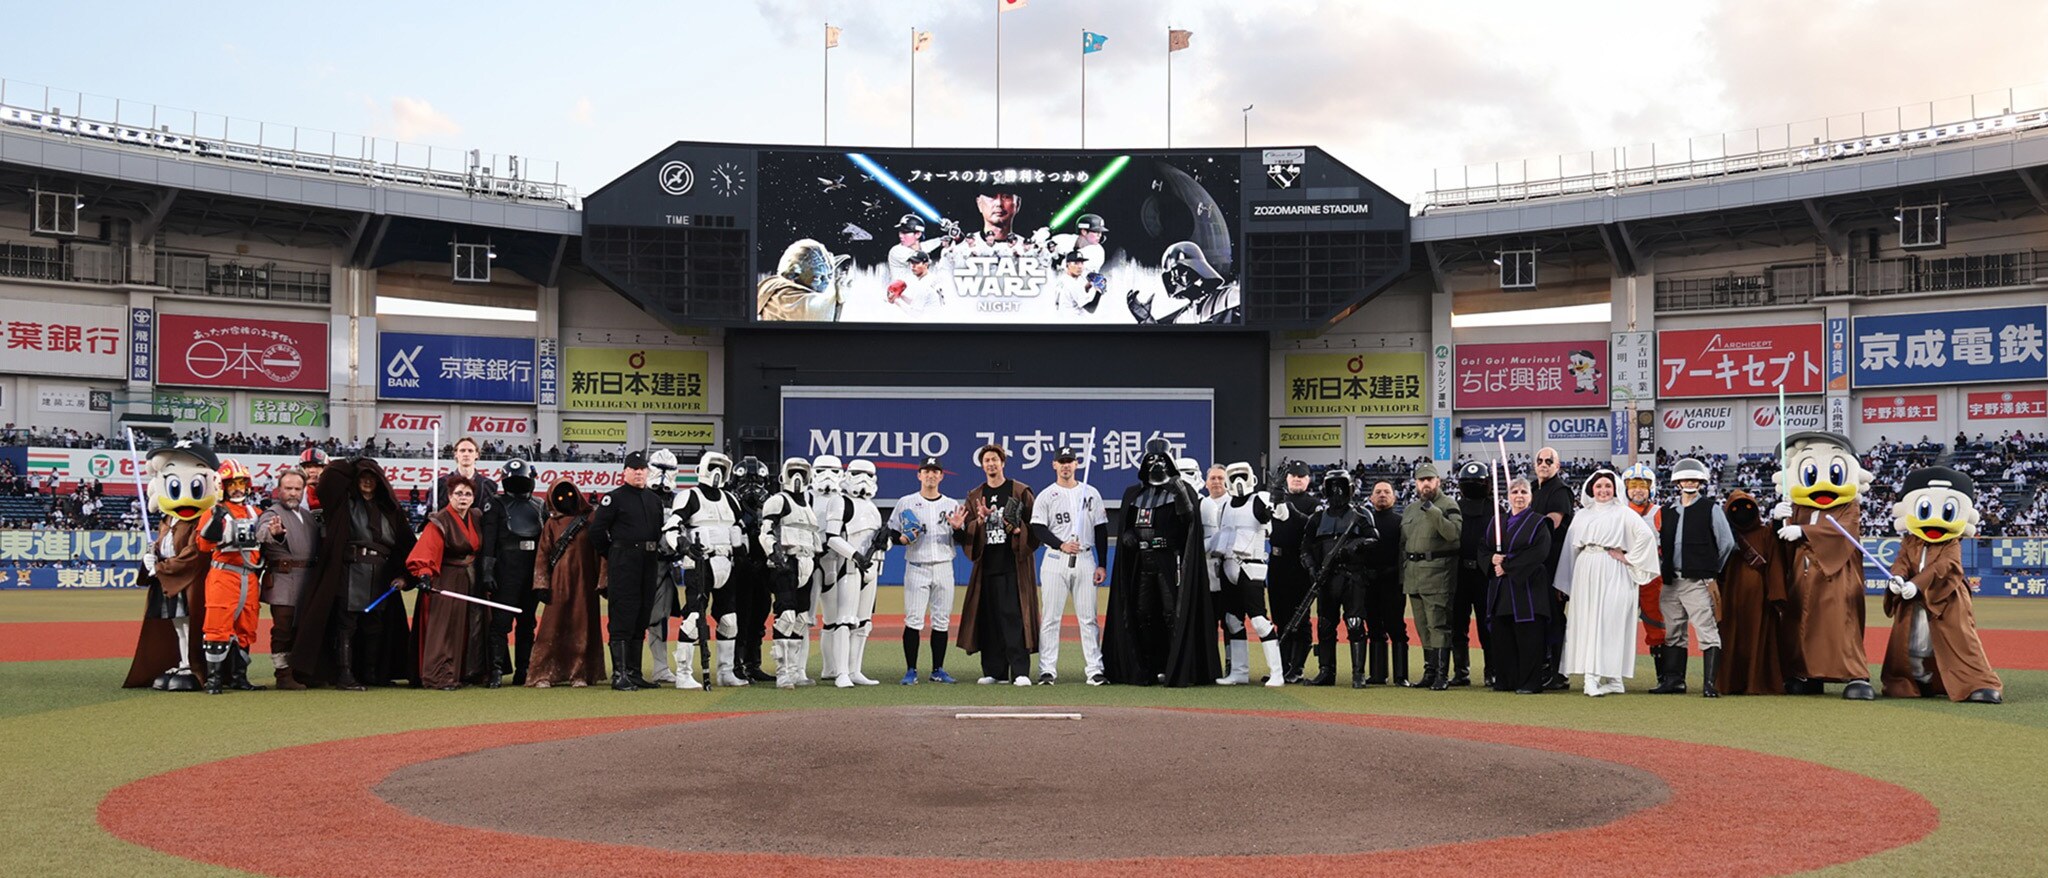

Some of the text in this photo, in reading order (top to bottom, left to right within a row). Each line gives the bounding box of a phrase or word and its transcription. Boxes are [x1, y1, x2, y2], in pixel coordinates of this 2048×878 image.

[909, 169, 1089, 185] フォースの力で勝利をつかめ
[1254, 204, 1369, 216] ZOZOMARINE STADIUM
[665, 215, 689, 225] TIME
[955, 255, 1045, 277] STAR
[954, 277, 1048, 298] WARS
[977, 301, 1022, 312] NIGHT
[0, 321, 119, 355] 葉銀行
[1723, 340, 1773, 349] ARCHICEPT
[134, 330, 149, 379] 飛田建設
[1859, 323, 2045, 371] 京成電鉄
[1461, 356, 1560, 366] Go! Go! Marines!
[439, 356, 532, 383] 京葉銀行
[1662, 350, 1820, 391] アーキセプト
[388, 378, 420, 388] BANK
[541, 357, 555, 404] 大森工業
[572, 371, 701, 397] 新日本建設
[1460, 366, 1562, 393] ちば興銀
[1292, 375, 1420, 400] 新日本建設
[254, 401, 300, 412] そらまめ
[573, 400, 700, 410] INTELLIGENT DEVELOPER
[1293, 404, 1419, 414] INTELLIGENT DEVELOPER
[254, 412, 287, 423] 保育園
[1683, 407, 1731, 419] MARUEI
[1484, 423, 1525, 438] オグラ
[1548, 418, 1608, 433] OGURA
[1687, 418, 1726, 430] Group
[653, 430, 712, 438] エクセレントシティ
[1367, 432, 1426, 440] エクセレントシティ
[808, 428, 950, 457] MIZUHO
[535, 470, 625, 487] のお求めは
[1055, 511, 1071, 524] 99
